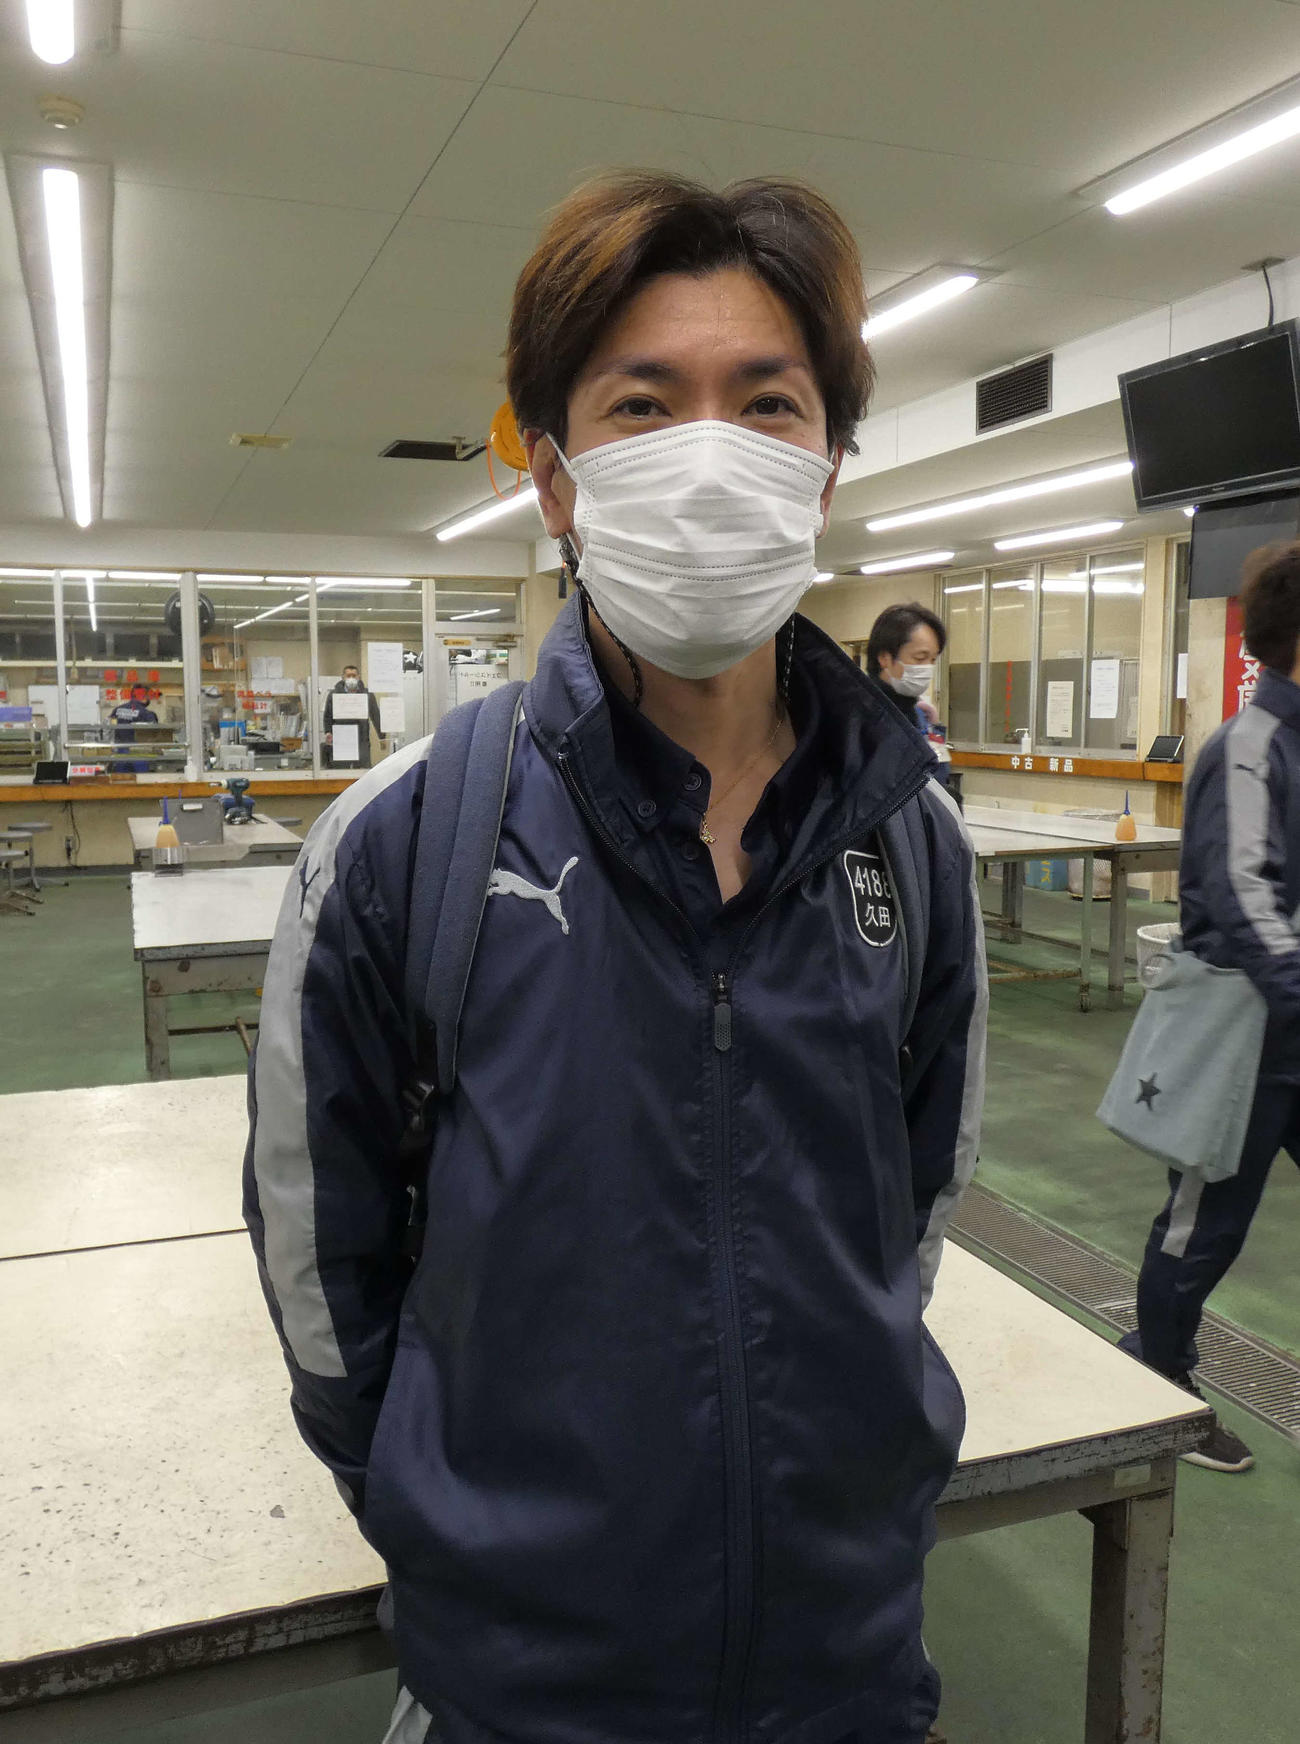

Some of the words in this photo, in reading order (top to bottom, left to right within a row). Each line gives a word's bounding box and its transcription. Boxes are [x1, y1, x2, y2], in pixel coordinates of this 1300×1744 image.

[1011, 755, 1033, 770] 中古
[1049, 757, 1073, 773] 新品
[865, 902, 891, 928] 久田
